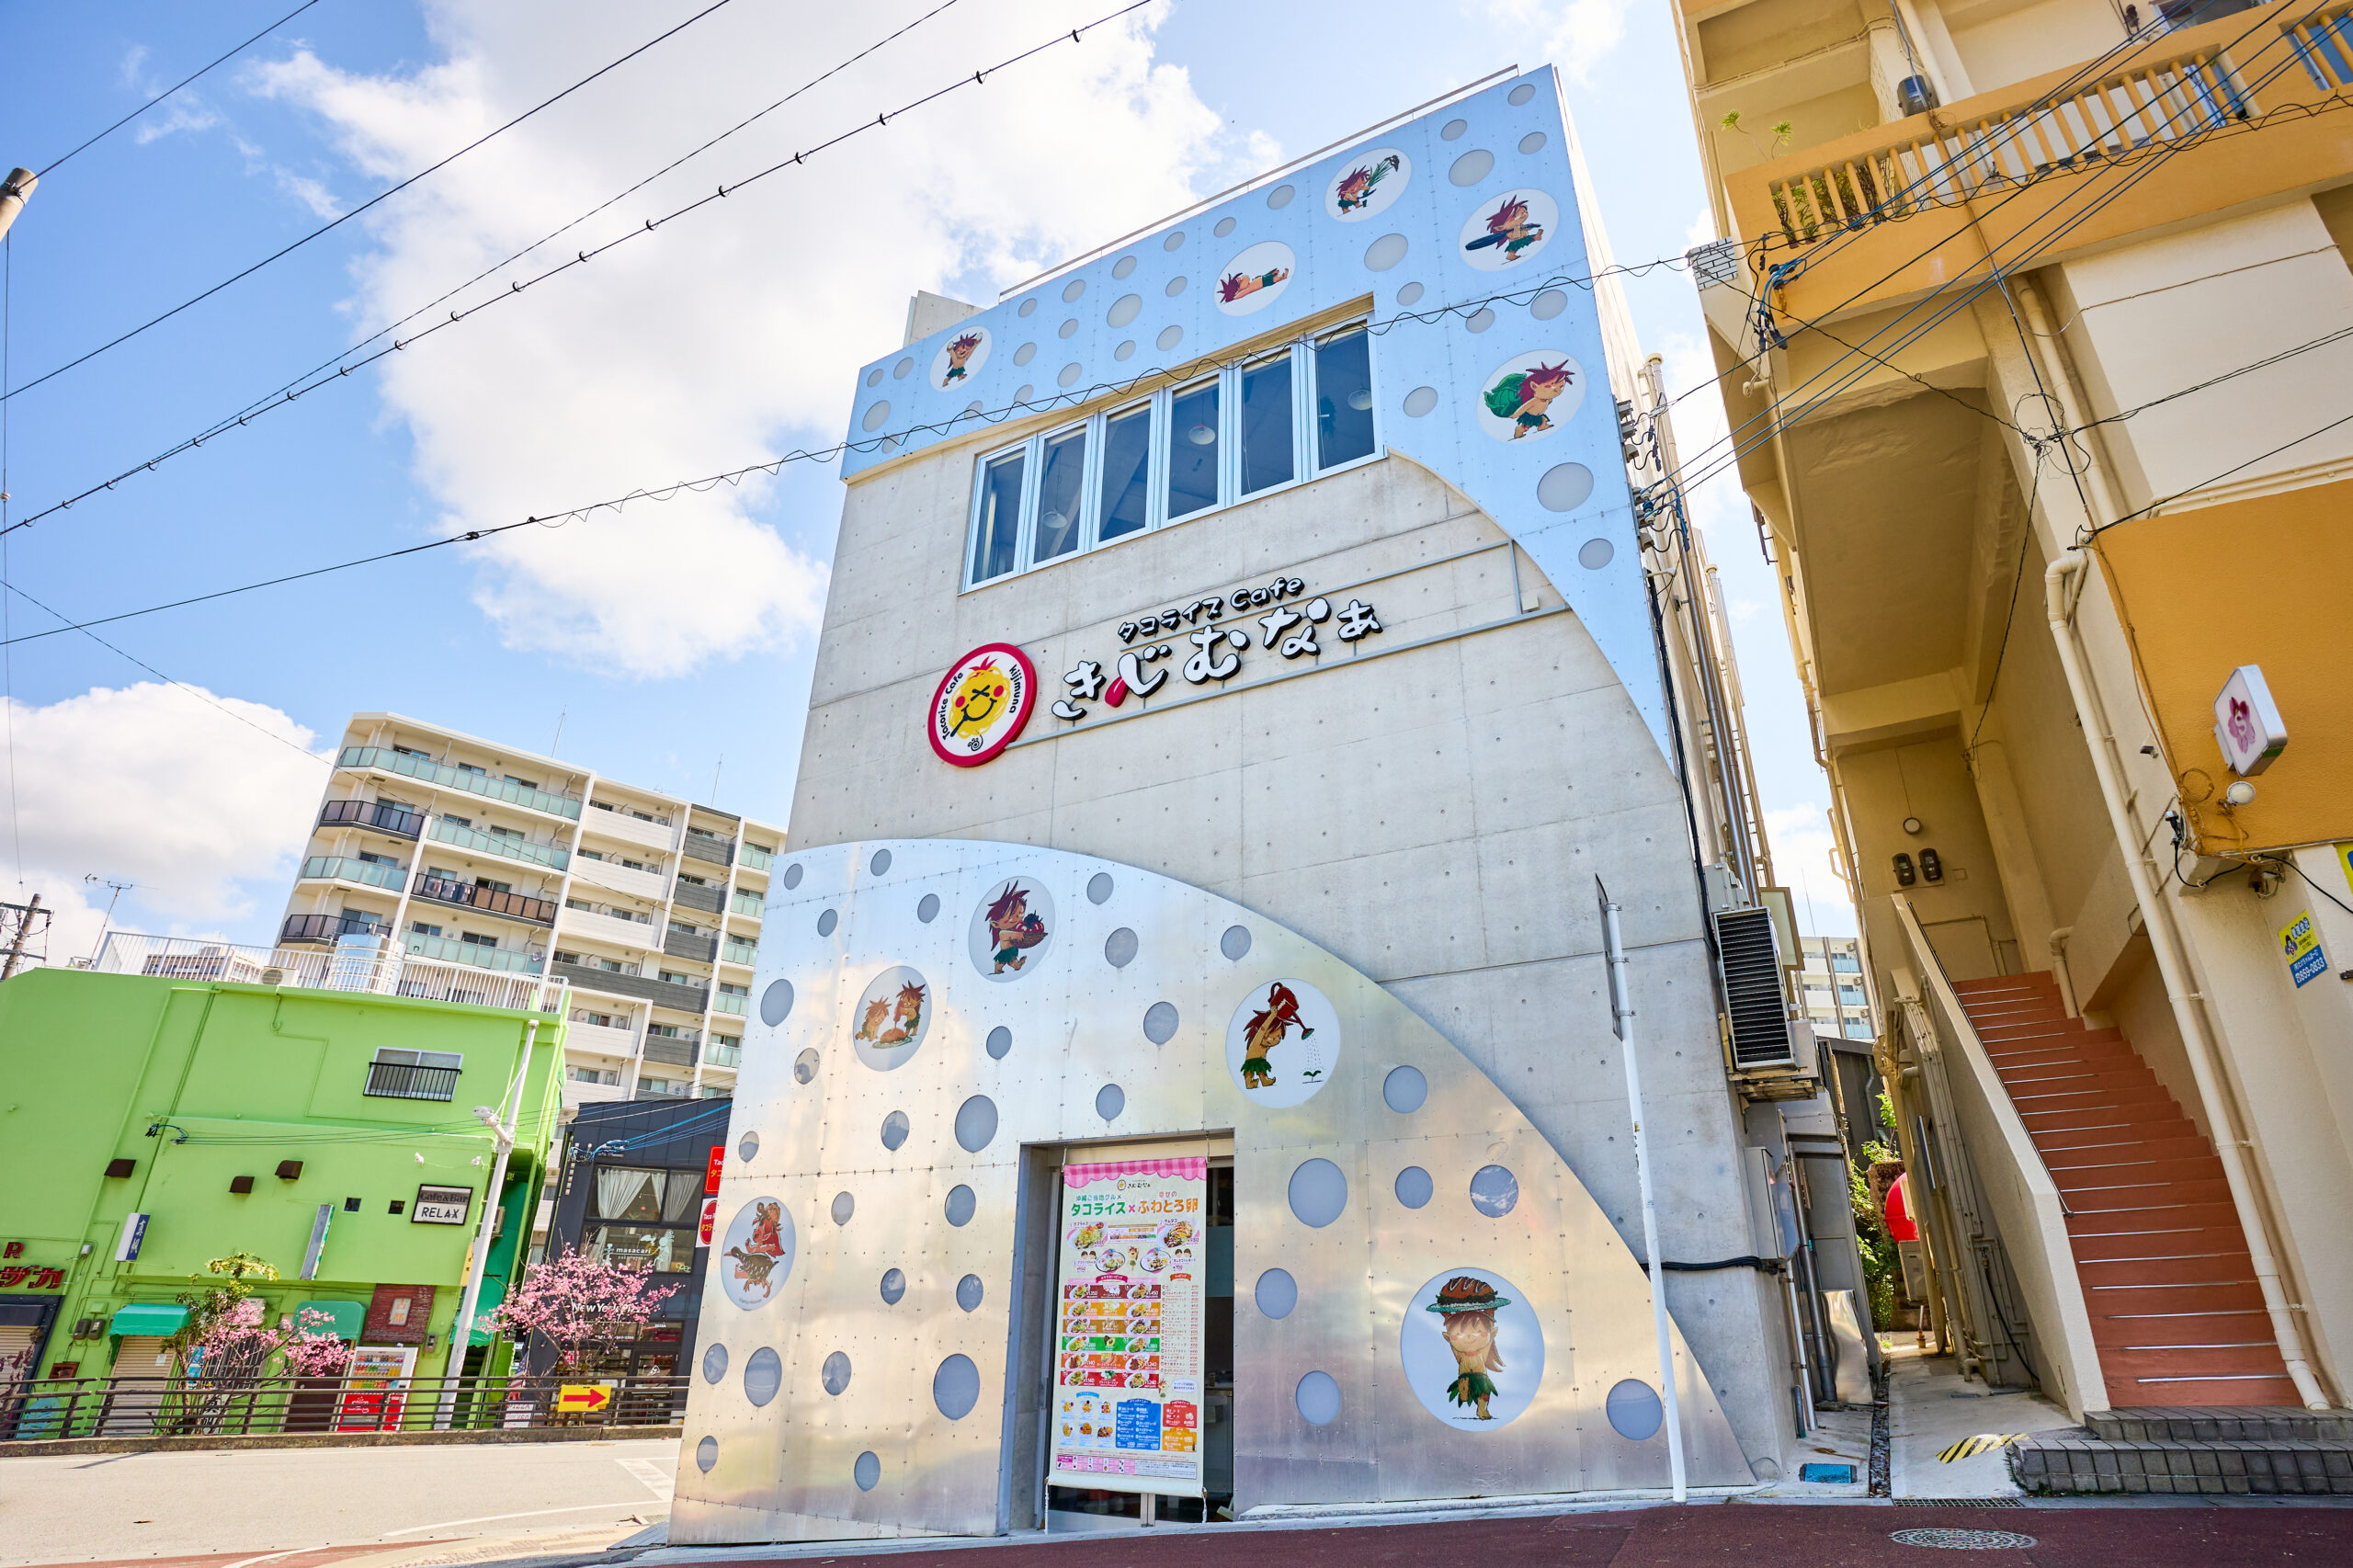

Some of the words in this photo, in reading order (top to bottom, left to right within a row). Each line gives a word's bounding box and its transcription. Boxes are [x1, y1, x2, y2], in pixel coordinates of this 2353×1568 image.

[1118, 596, 1223, 642] タコライス
[1230, 576, 1304, 612] Cafe
[938, 698, 951, 741] Tacorice
[945, 672, 964, 695] Cafe
[421, 1207, 460, 1220] RELAX
[1071, 1201, 1126, 1217] タコライス
[1138, 1198, 1199, 1214] ふわとろ卵
